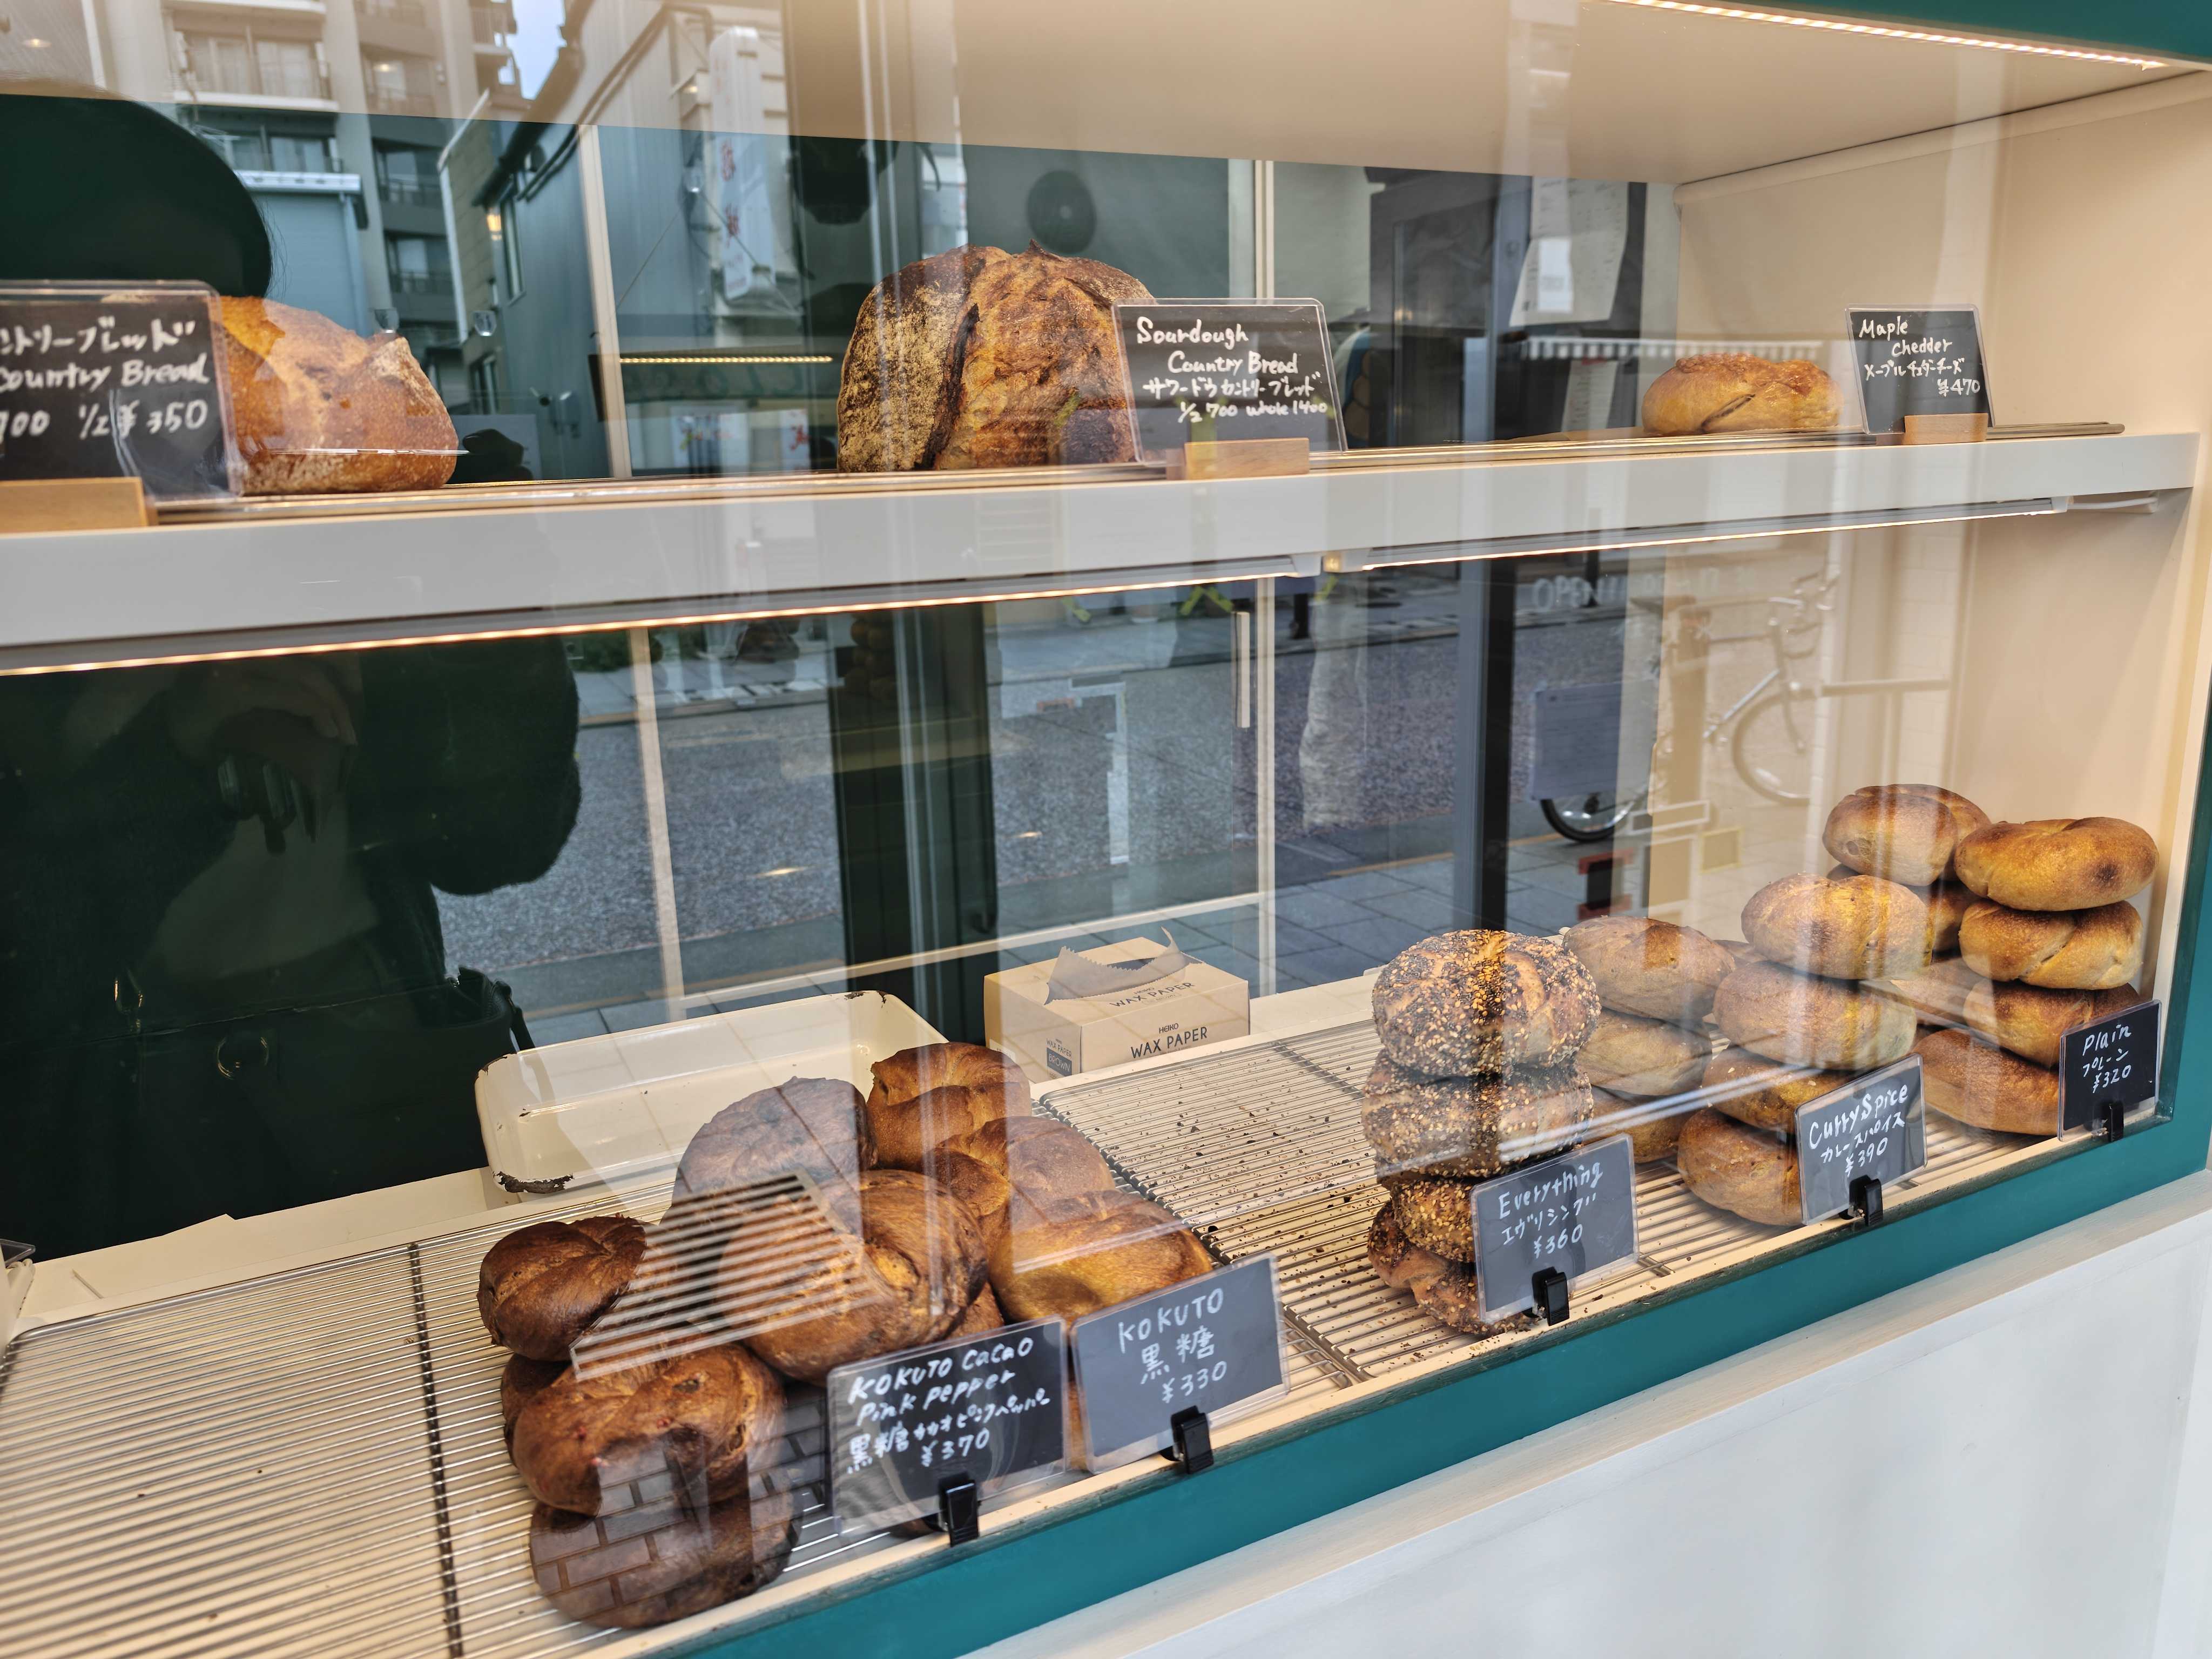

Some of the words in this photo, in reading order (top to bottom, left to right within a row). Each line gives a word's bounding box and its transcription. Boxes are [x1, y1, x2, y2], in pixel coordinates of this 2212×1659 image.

[1137, 316, 1249, 350] Sourdough
[1858, 315, 1908, 341] Maple
[121, 353, 210, 387] Bread
[1168, 350, 1243, 375] Country
[1247, 350, 1299, 374] Bread
[1937, 379, 1981, 397] ¥470
[1205, 402, 1238, 419] 700
[1109, 995, 1147, 1007] WAX
[1147, 982, 1196, 997] PAPER
[1130, 1038, 1162, 1059] WAX
[1166, 1026, 1208, 1049] PAPER
[1158, 1022, 1179, 1034] HEIKO
[2082, 1024, 2132, 1056] Plain
[1049, 1053, 1070, 1072] BROWN
[2082, 1048, 2129, 1077] プレーン
[2092, 1064, 2132, 1094] ¥320
[1845, 1137, 1888, 1177] ¥390
[1498, 1162, 1603, 1219] Everything
[1534, 1224, 1583, 1259] ¥360
[1118, 1288, 1224, 1354] KOKUTO
[848, 1357, 953, 1404] KOKUTO
[1162, 1360, 1227, 1404] ¥330
[921, 1427, 990, 1467] ¥370
